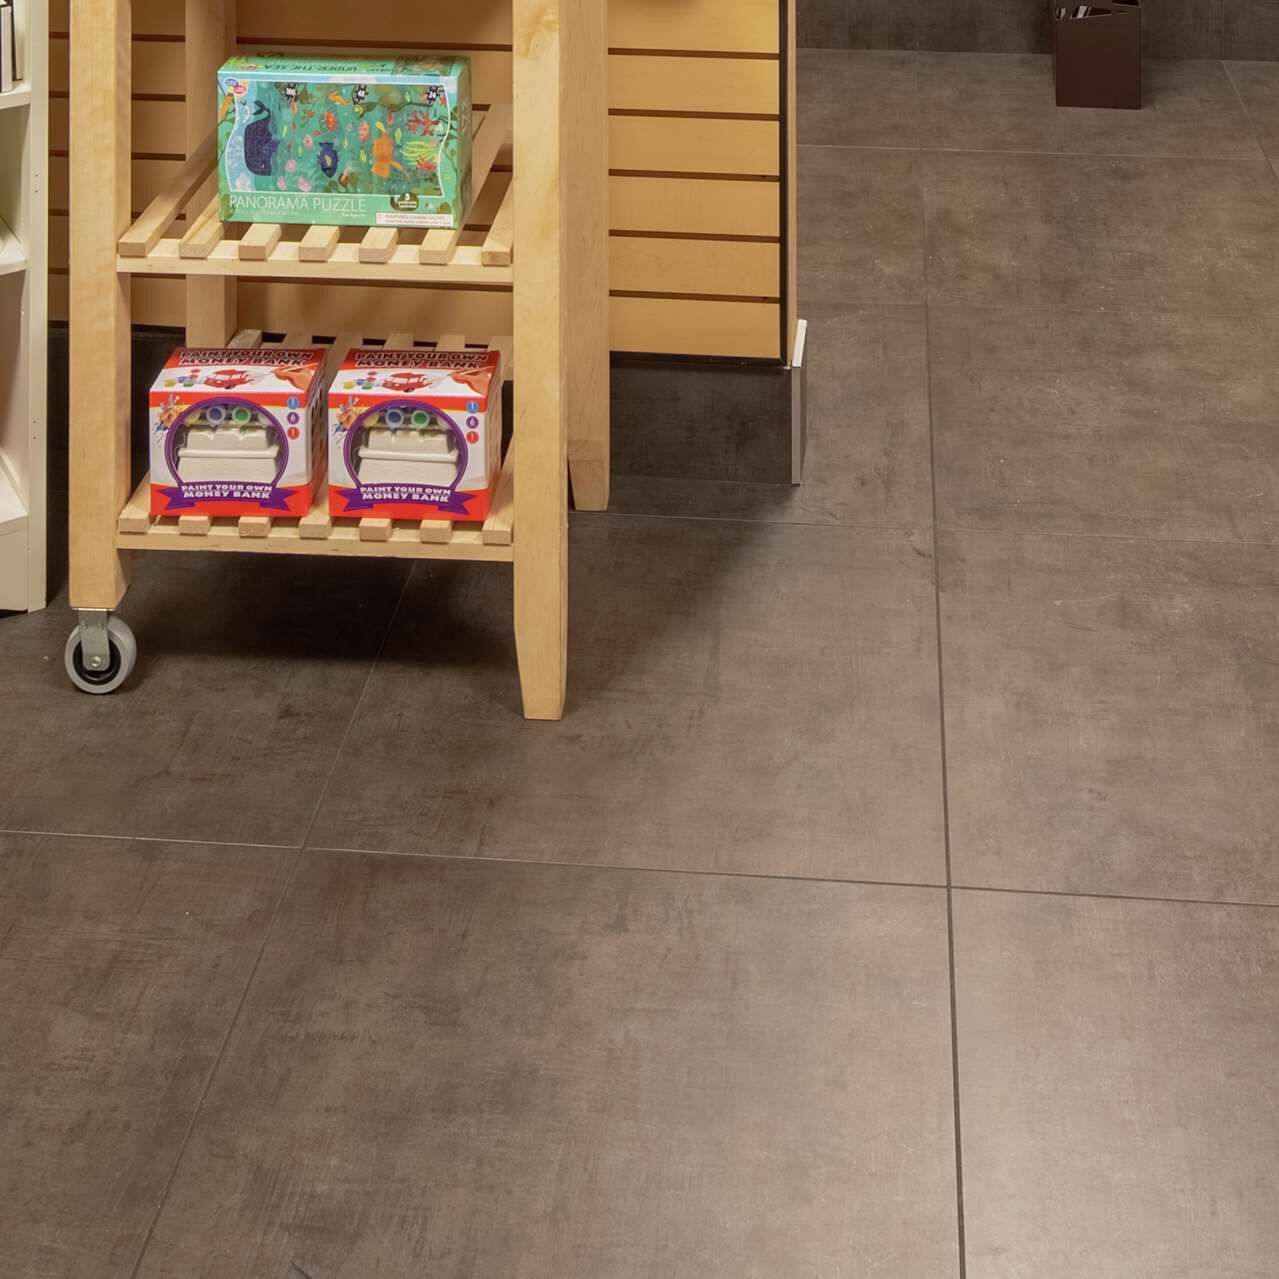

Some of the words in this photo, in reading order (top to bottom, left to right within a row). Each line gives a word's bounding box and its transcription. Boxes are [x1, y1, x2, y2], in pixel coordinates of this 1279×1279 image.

[229, 195, 309, 210] PANORAMA
[313, 196, 367, 212] PUZZLE
[181, 350, 228, 360] PAINT
[230, 351, 276, 359] YOUR
[277, 352, 313, 361] OWN
[359, 353, 406, 361] PAINT
[407, 353, 454, 362] YOUR
[454, 354, 489, 363] OWN
[178, 358, 242, 367] MONEY
[248, 358, 306, 367] BANK
[356, 360, 420, 368] MONEY
[425, 360, 483, 369] BANK
[182, 484, 211, 492] PAINT
[244, 485, 272, 493] OWN
[393, 487, 421, 495] YOUR
[423, 488, 451, 496] OWN
[235, 491, 270, 499] BANK
[362, 493, 410, 501] MONEY
[414, 494, 449, 502] BANK
